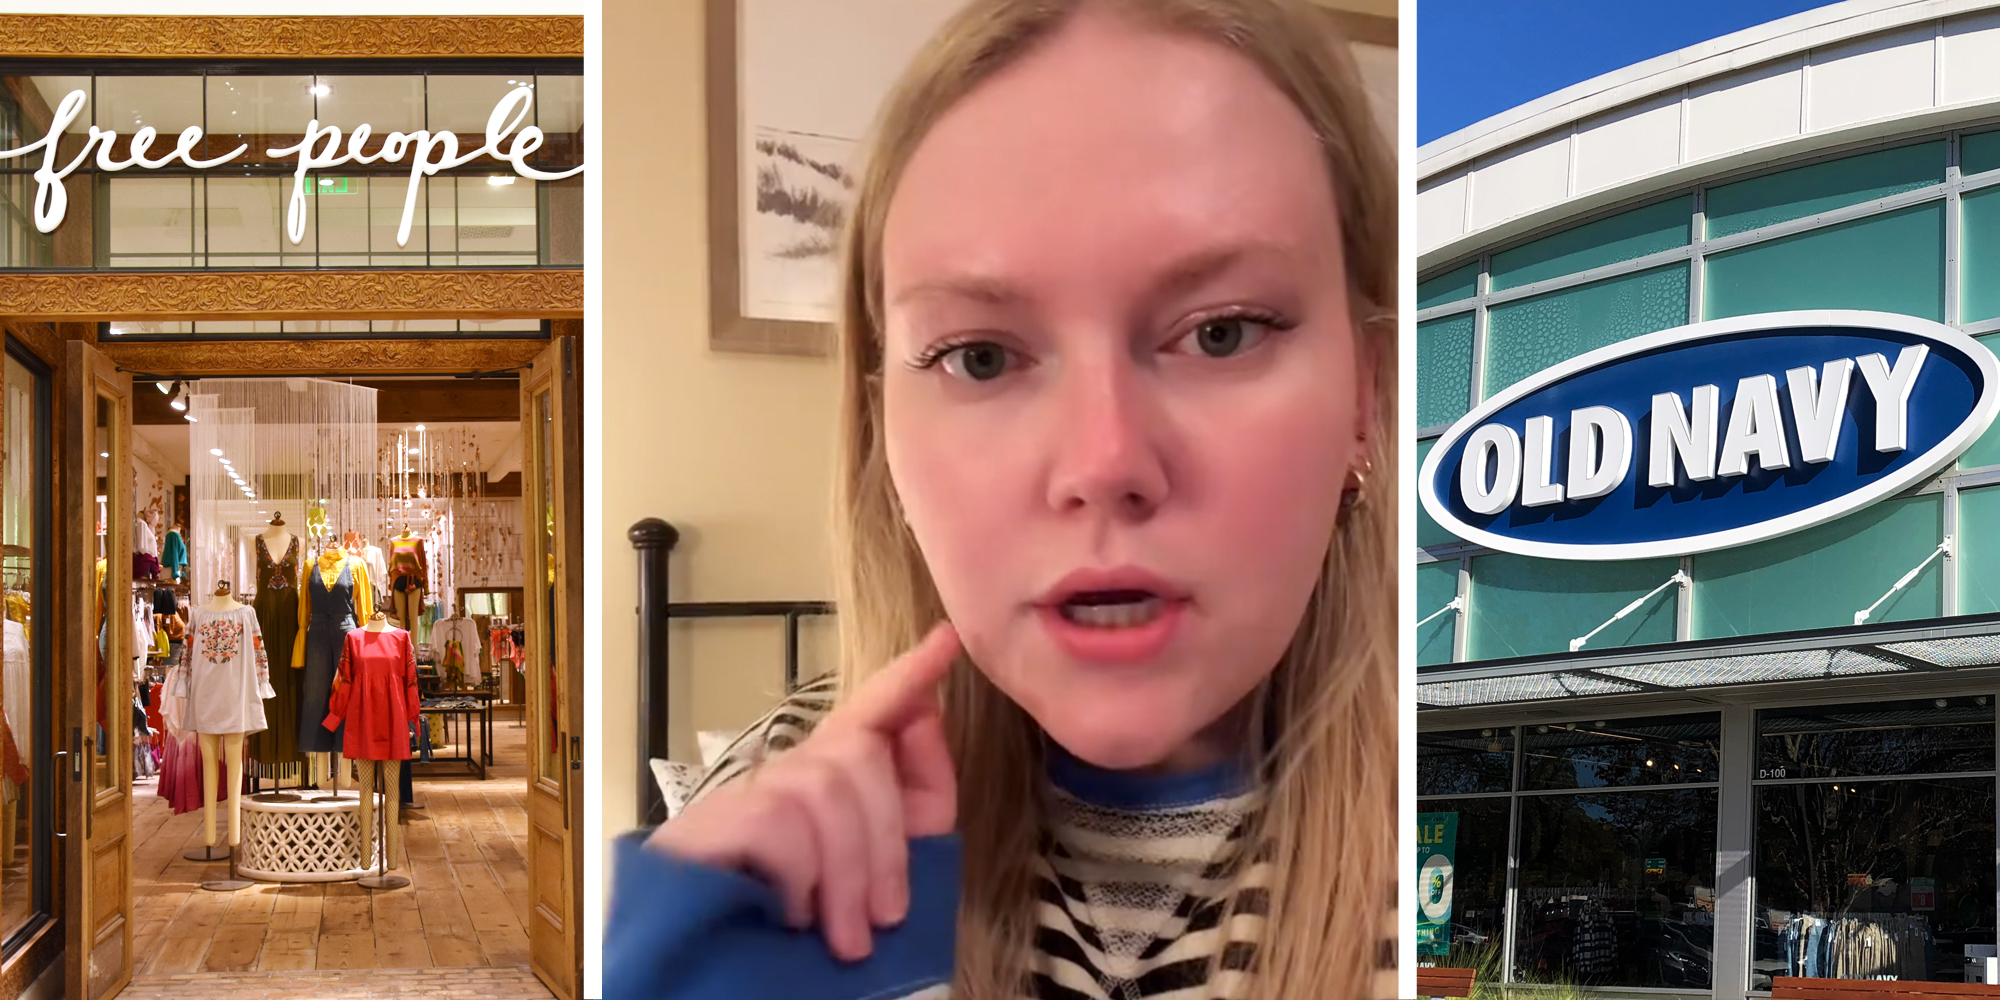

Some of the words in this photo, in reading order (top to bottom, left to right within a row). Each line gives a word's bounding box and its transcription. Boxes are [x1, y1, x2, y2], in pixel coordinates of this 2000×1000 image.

[0, 89, 248, 233] free
[266, 86, 584, 247] people
[1459, 404, 1633, 515] OLD
[1648, 343, 1931, 488] NAVY
[1760, 769, 1786, 778] D-100
[1422, 846, 1430, 854] TO
[1417, 853, 1454, 918] 0
